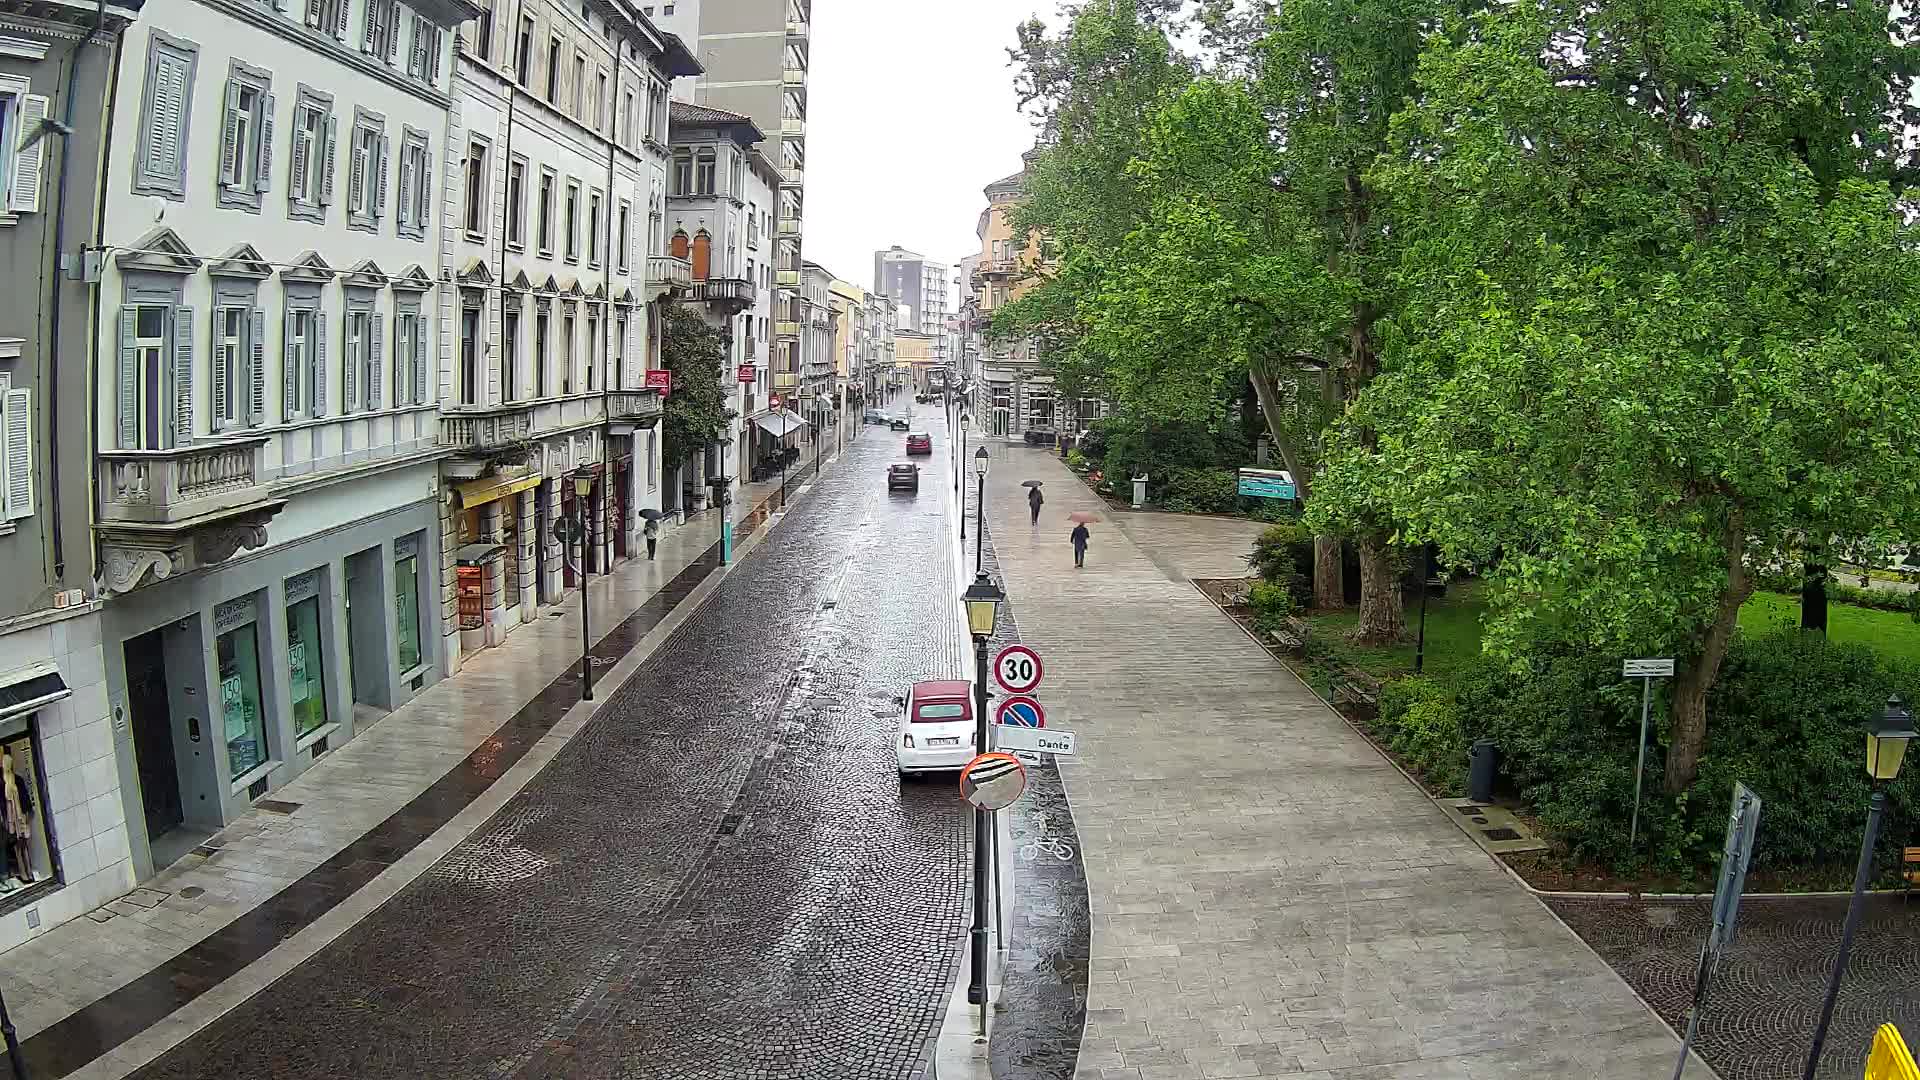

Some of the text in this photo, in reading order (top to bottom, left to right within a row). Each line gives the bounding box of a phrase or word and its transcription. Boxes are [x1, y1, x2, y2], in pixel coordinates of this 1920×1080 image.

[1005, 659, 1032, 680] 30
[223, 678, 240, 700] 130
[1039, 739, 1069, 750] Dante
